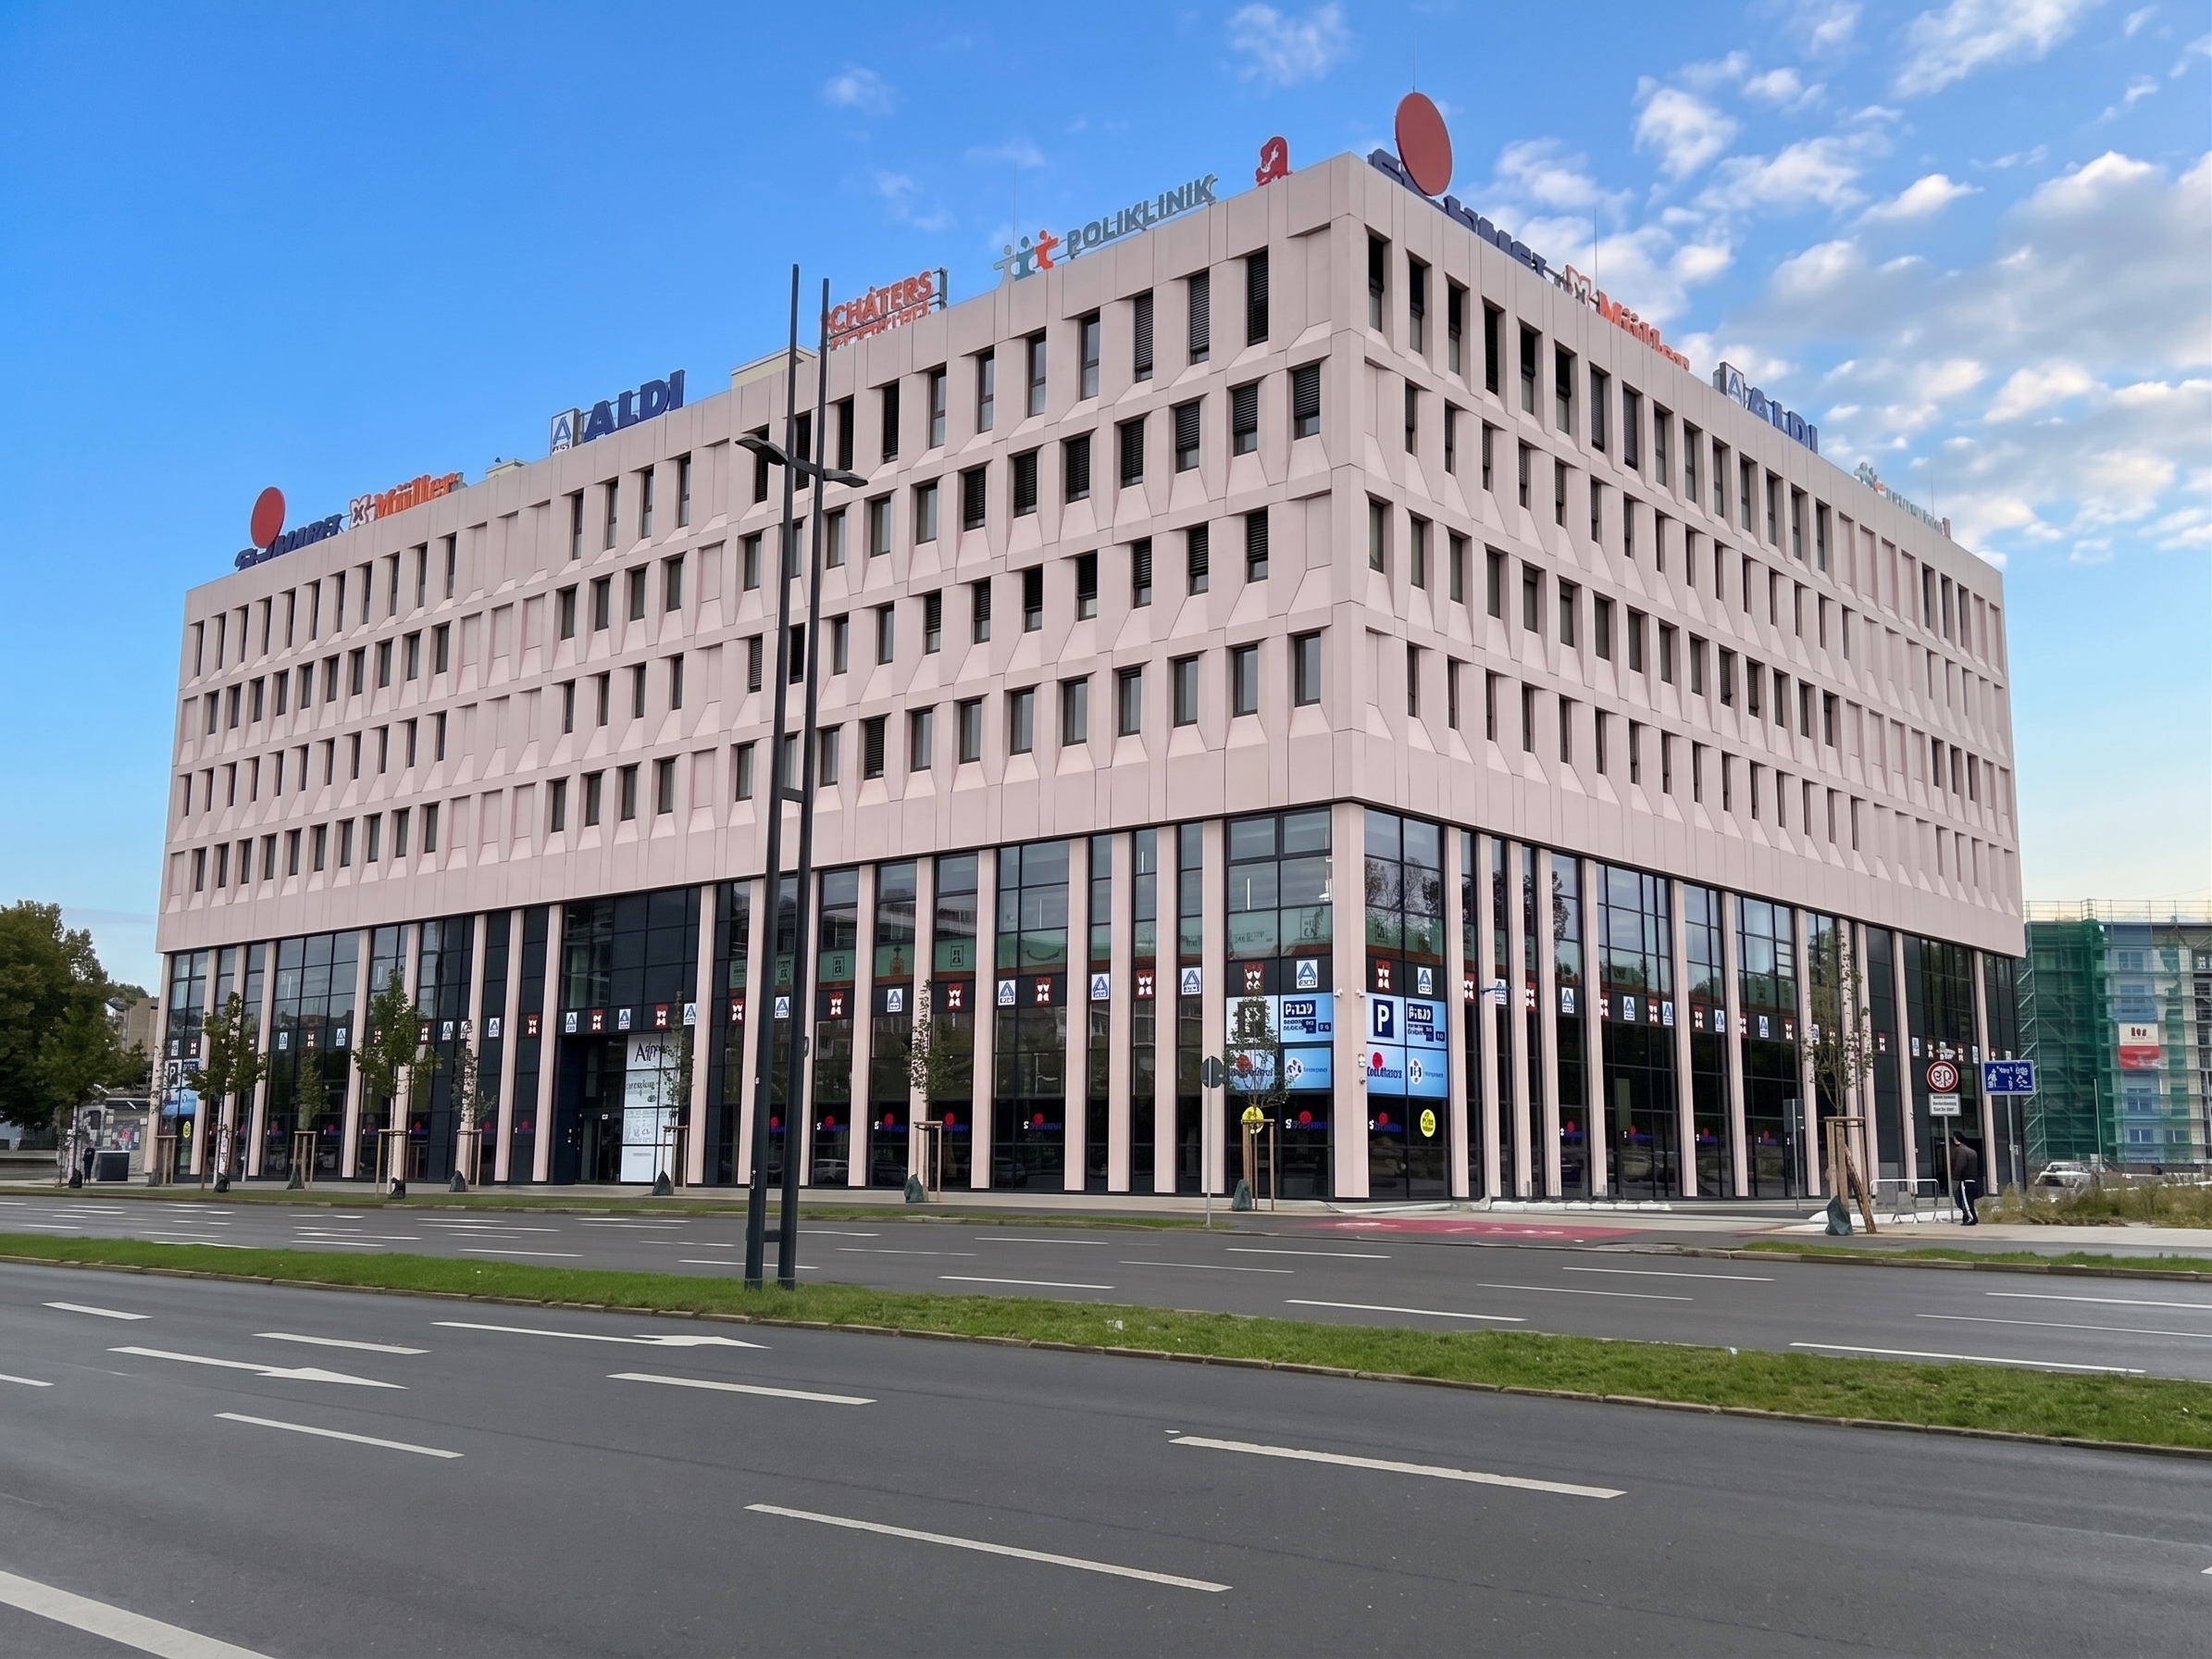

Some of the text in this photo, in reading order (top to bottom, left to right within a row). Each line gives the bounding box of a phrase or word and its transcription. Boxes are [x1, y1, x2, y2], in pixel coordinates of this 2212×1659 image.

[1067, 174, 1218, 256] POLIKLINIK
[583, 369, 686, 443] ALDI
[1747, 387, 1819, 454] ALDI
[1377, 1004, 1390, 1032] P
